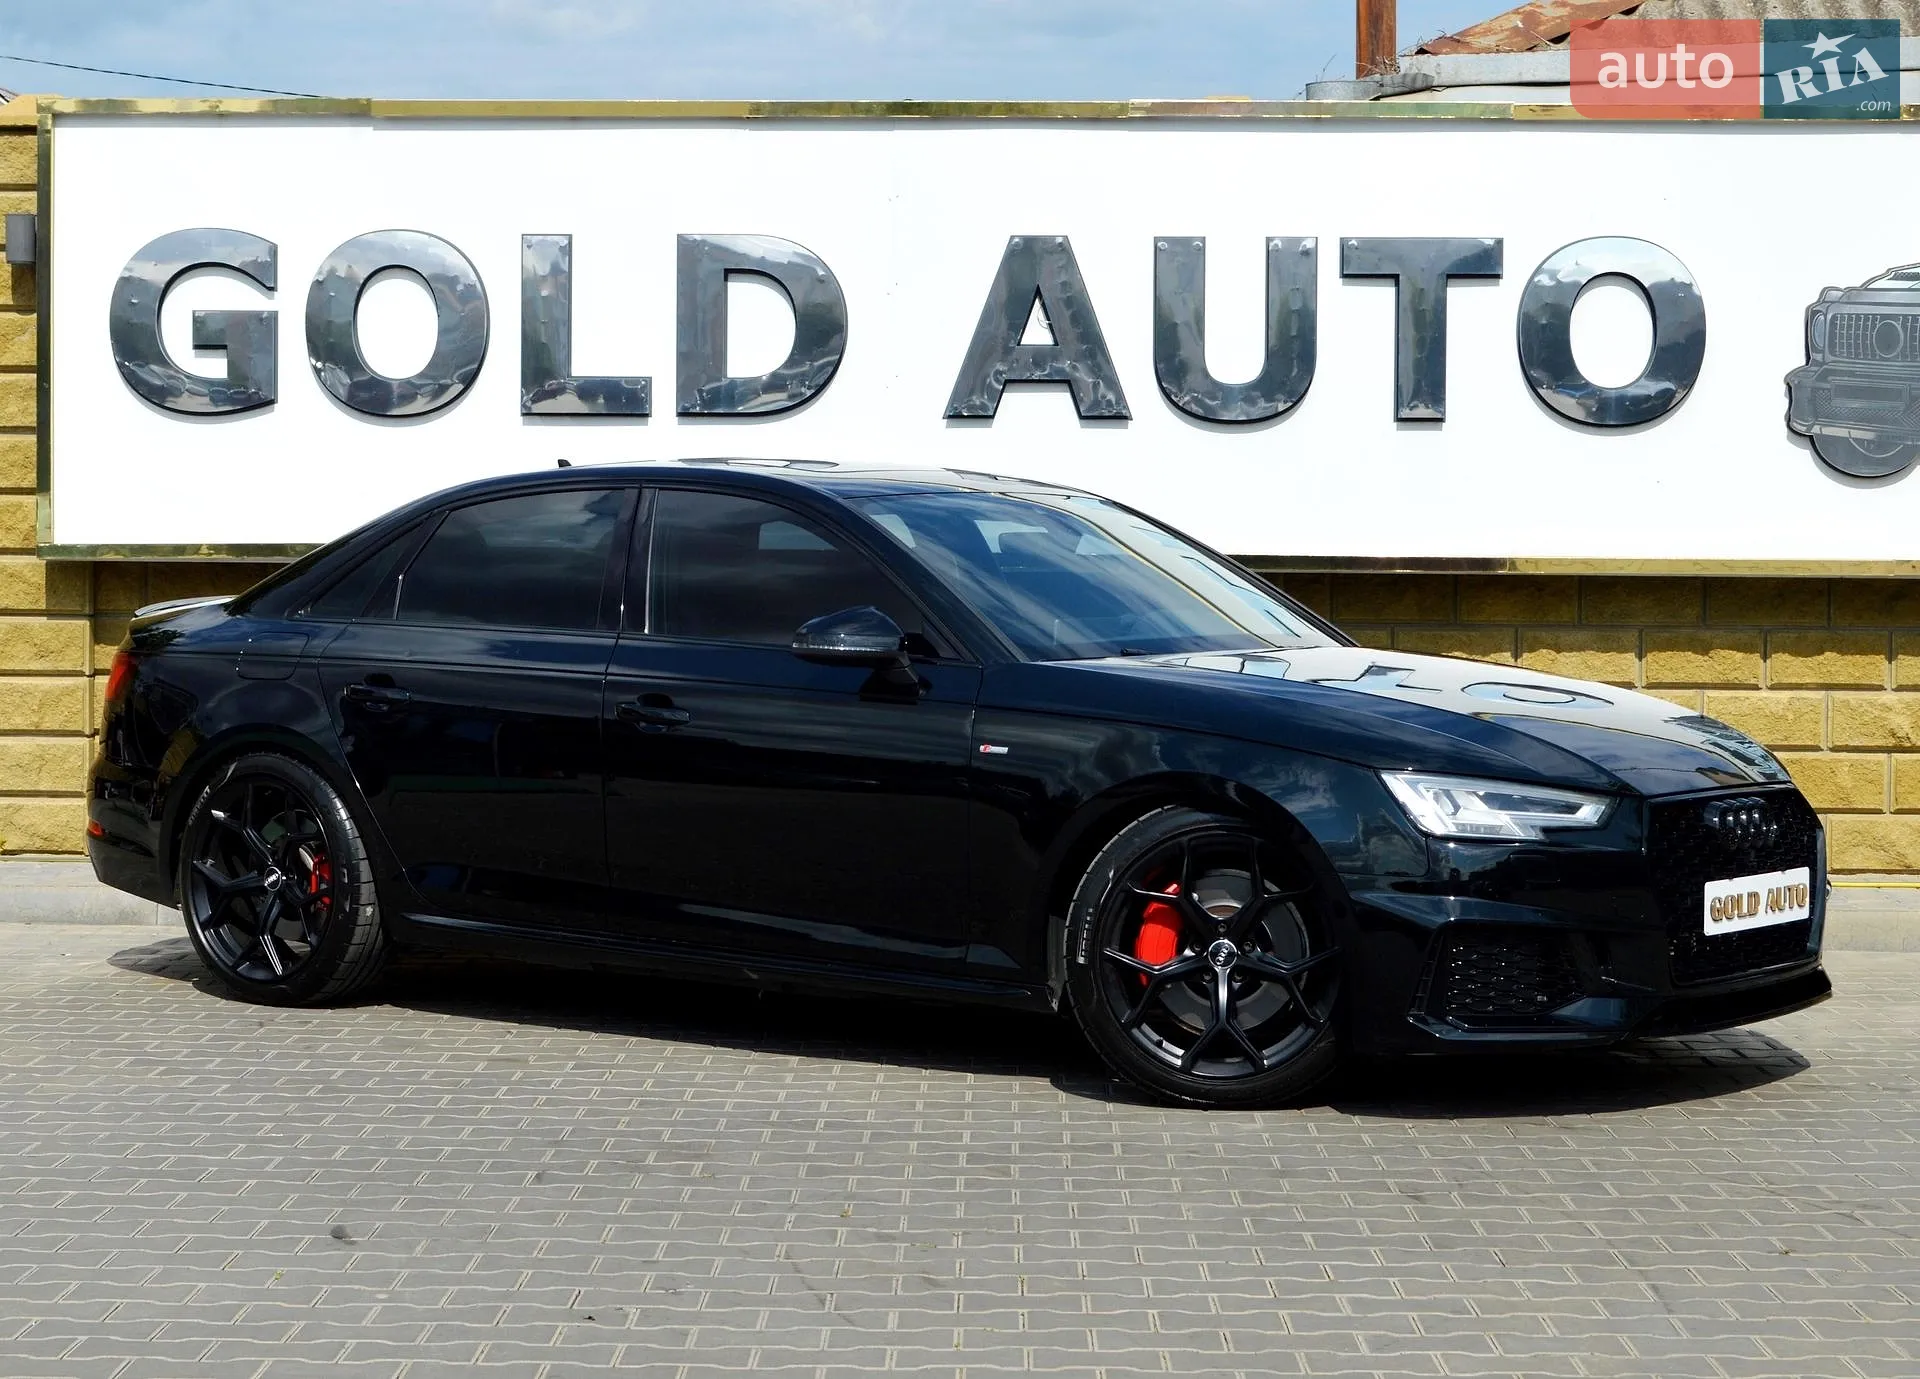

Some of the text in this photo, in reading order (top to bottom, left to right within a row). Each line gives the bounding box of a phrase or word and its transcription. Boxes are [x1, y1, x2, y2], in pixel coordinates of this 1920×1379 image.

[109, 227, 1707, 428] GOLD AUTO
[1710, 883, 1808, 922] GOLD AUTO
